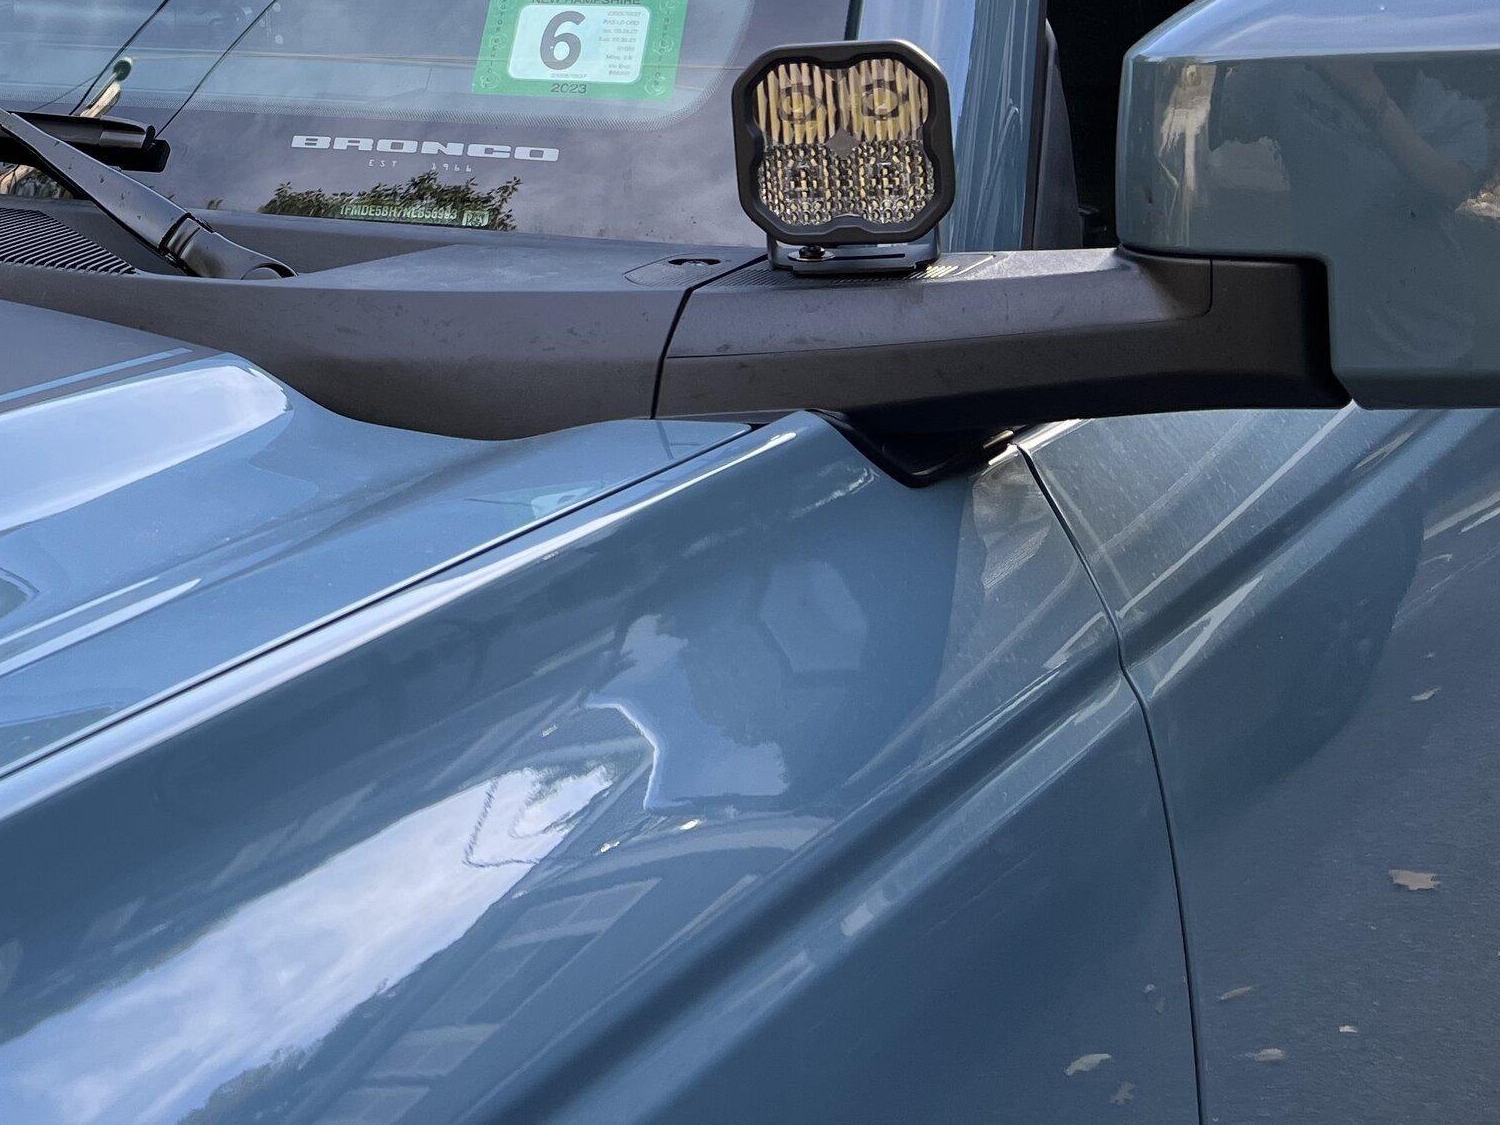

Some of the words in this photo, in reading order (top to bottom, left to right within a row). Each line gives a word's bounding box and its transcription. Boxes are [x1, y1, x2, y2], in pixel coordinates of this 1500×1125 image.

[540, 10, 586, 71] 6
[550, 83, 587, 94] 2023
[291, 135, 560, 162] BRONCO
[369, 159, 397, 168] EST
[431, 162, 472, 172] 1966
